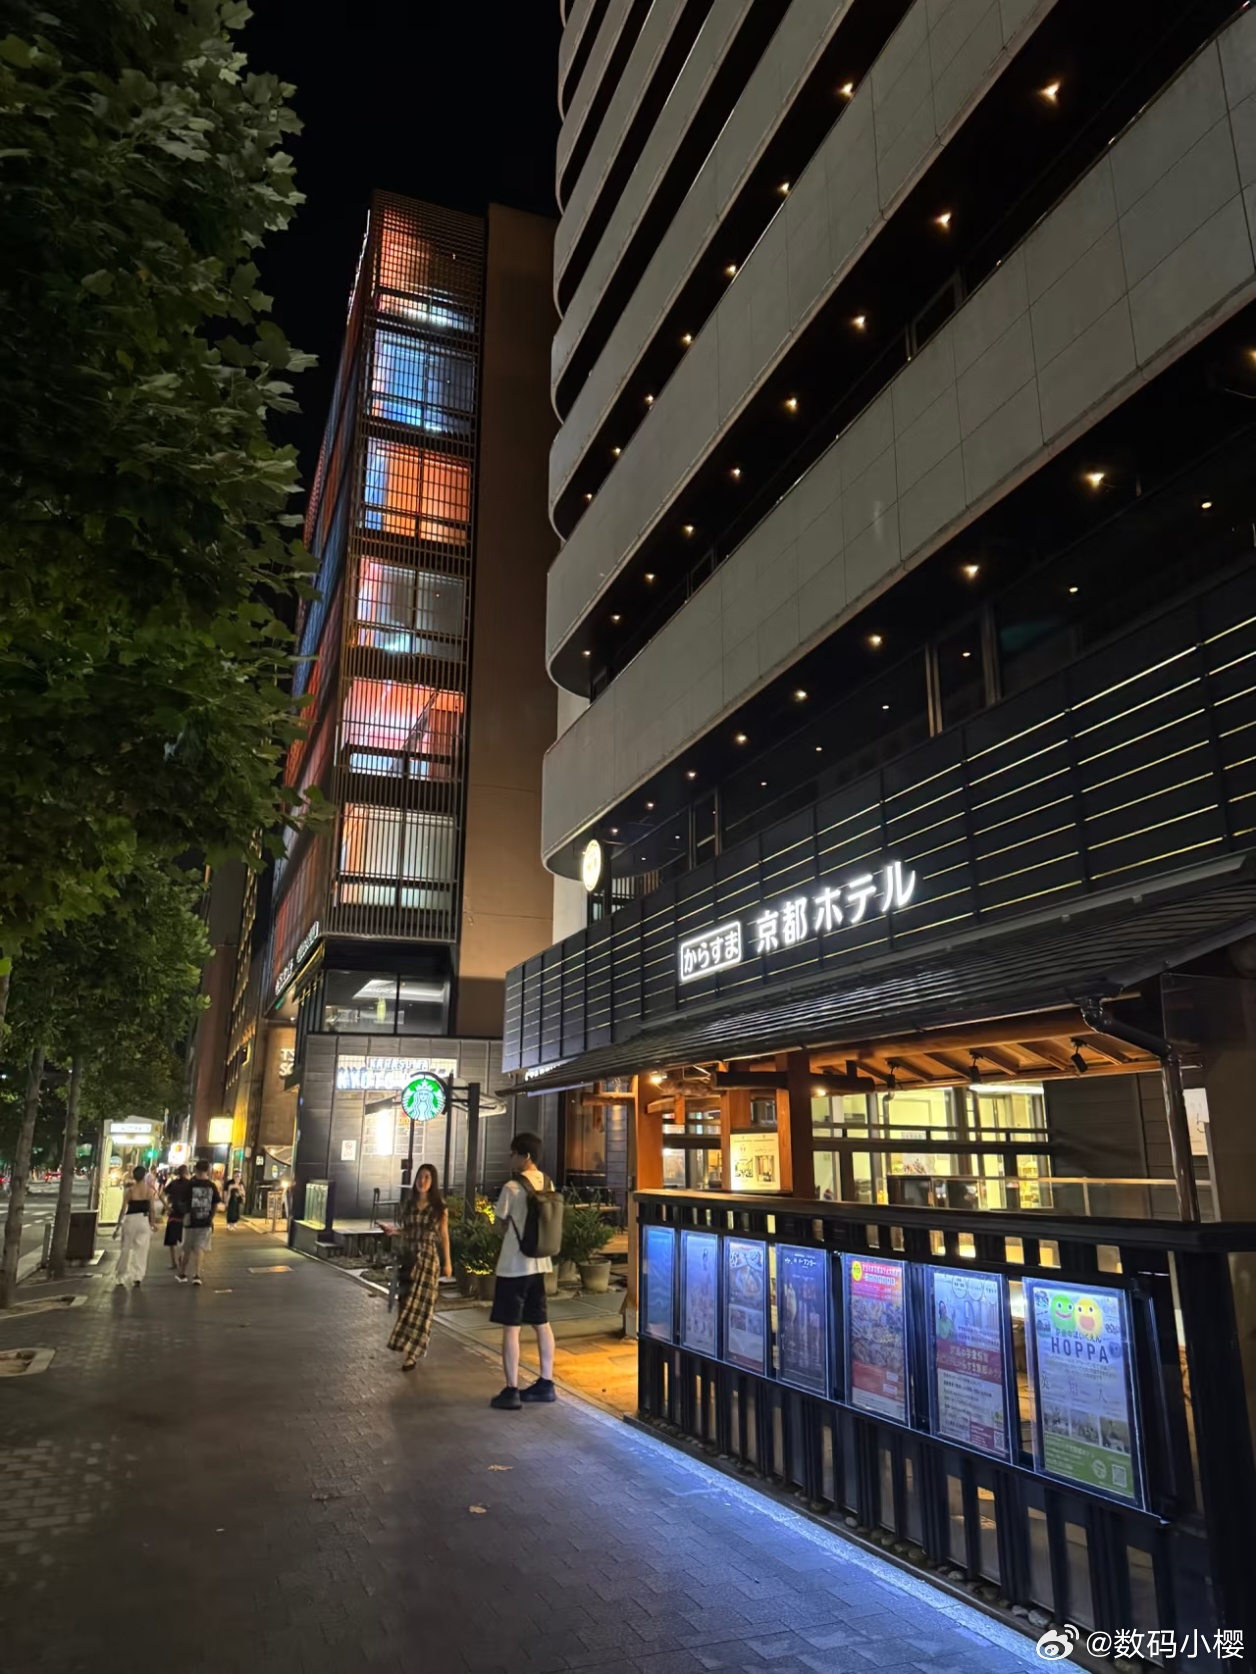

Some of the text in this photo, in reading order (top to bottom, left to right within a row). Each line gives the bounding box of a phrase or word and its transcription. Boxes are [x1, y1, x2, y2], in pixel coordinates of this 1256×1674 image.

[683, 860, 917, 974] からすま 京都ホテル
[1051, 1337, 1109, 1364] HOPPA
